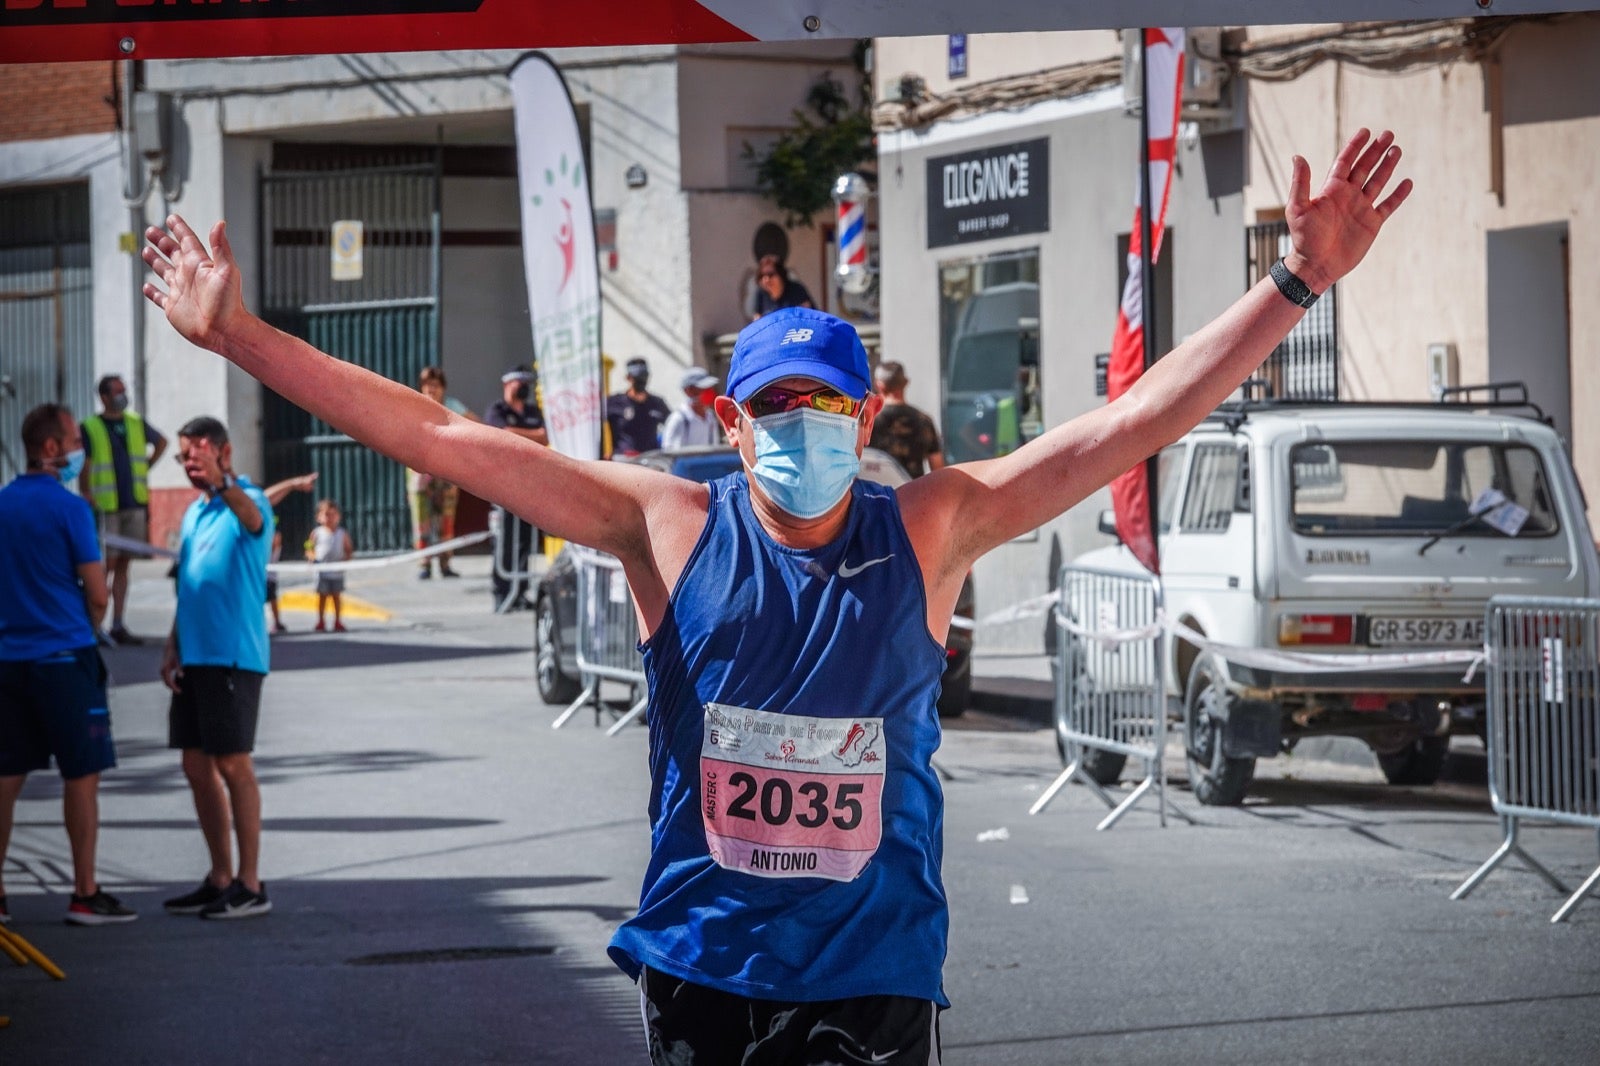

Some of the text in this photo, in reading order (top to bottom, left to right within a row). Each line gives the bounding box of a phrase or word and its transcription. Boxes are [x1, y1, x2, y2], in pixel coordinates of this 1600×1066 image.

[706, 771, 717, 820] MASTER C
[726, 771, 864, 830] 2035
[750, 848, 818, 871] ANTONIO
